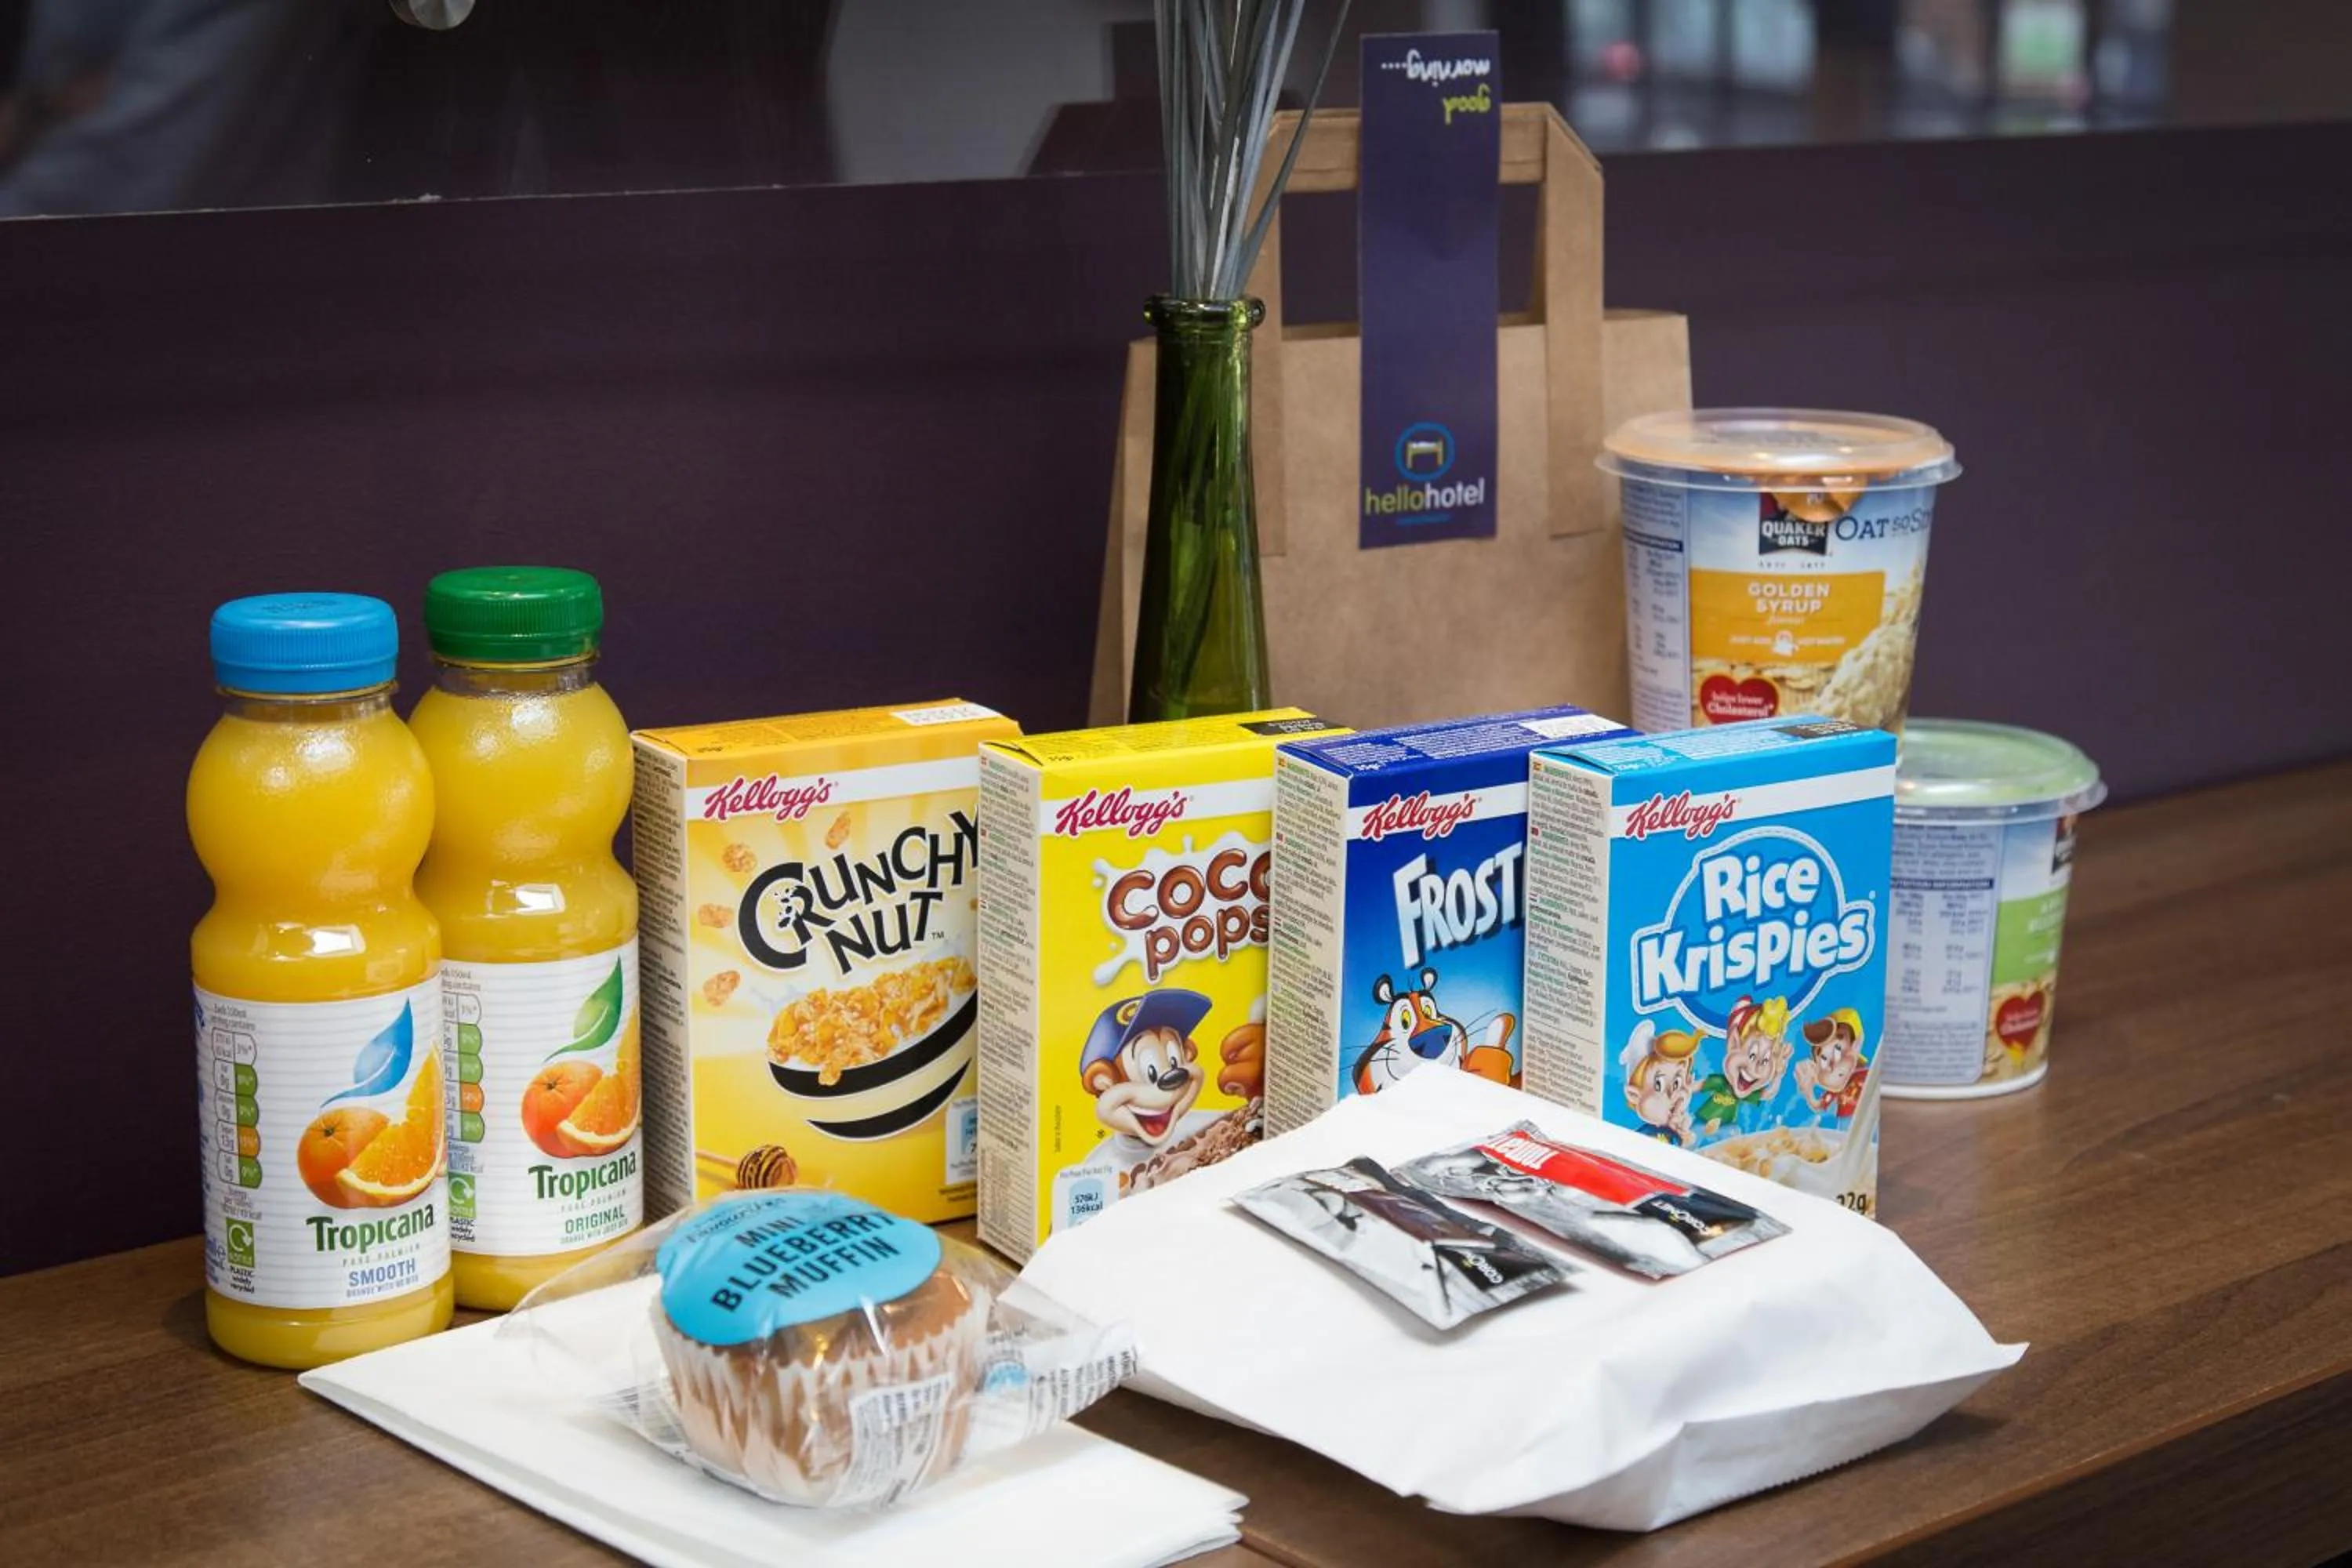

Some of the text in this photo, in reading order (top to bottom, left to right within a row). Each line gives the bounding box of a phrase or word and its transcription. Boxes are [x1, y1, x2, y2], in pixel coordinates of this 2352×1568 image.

[1443, 83, 1490, 125] good
[1365, 477, 1485, 515] hellohotel
[1762, 520, 1825, 538] QUAKER
[1777, 535, 1809, 546] OATS
[1835, 515, 1889, 541] OAT
[1748, 583, 1830, 597] GOLDEN
[1756, 599, 1822, 614] SYRUP
[704, 775, 832, 821] Kellogg's
[1055, 789, 1186, 837] Kellogg's
[1362, 792, 1475, 839] Kellogg's
[1626, 792, 1734, 837] Kellogg's
[738, 806, 978, 970] CRUNCHY
[1393, 841, 1523, 968] FROST
[1702, 855, 1820, 921] Rice
[826, 891, 942, 975] NUT
[1642, 911, 1867, 1000] Krispies
[528, 1151, 637, 1200] Tropicana
[306, 1203, 434, 1254] Tropicana
[564, 1203, 625, 1234] ORIGINAL
[735, 1216, 806, 1249] MINI
[349, 1257, 416, 1287] SMOOTH
[710, 1210, 895, 1313] BLUEBERRY
[766, 1236, 901, 1298] MUFFIN
